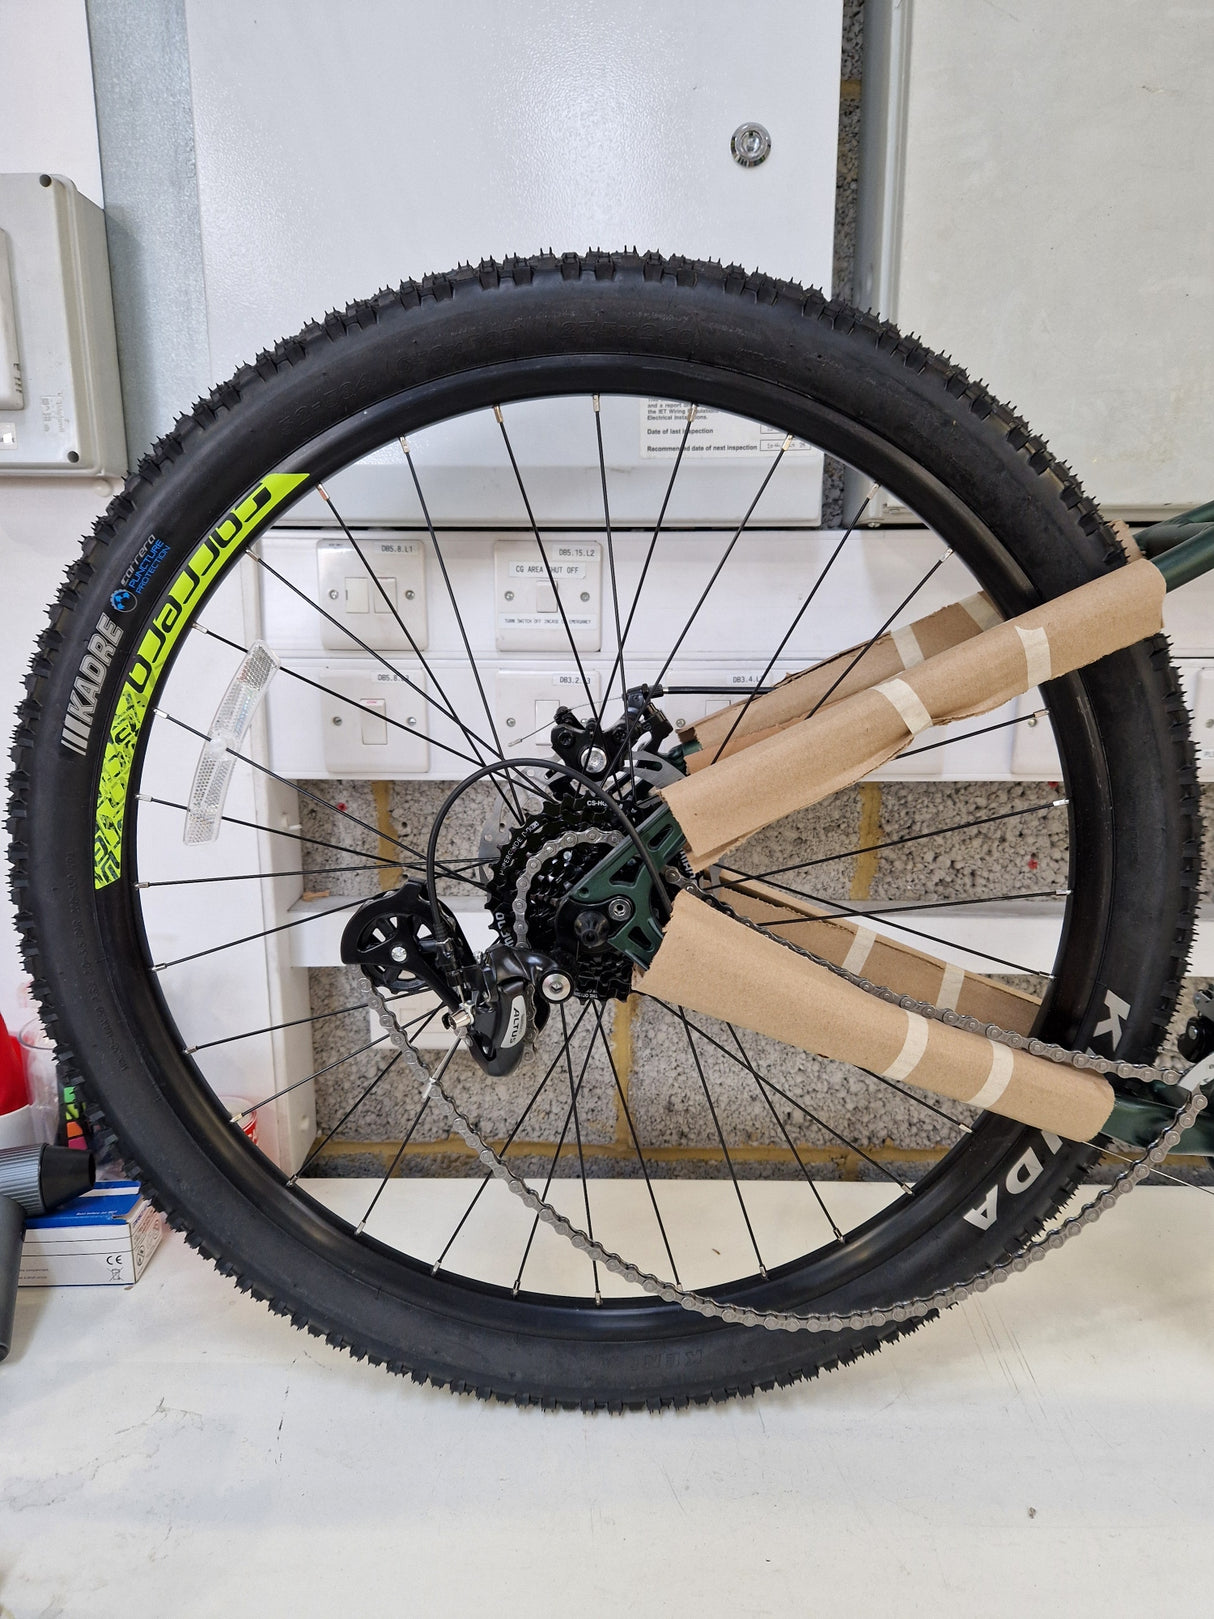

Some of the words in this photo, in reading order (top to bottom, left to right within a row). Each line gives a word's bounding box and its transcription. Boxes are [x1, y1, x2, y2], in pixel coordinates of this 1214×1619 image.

[683, 427, 714, 437] ispection
[121, 534, 156, 587] carrera
[128, 539, 165, 588] PUNCTURE
[381, 545, 413, 553] DB5.8.L1
[558, 548, 595, 557] DB5.15.L2
[135, 545, 171, 595] PROTECTION
[515, 565, 525, 573] CG
[527, 565, 544, 573] AREA
[548, 566, 563, 574] HUT
[566, 566, 579, 574] OFF
[126, 483, 272, 694] carrera
[66, 611, 124, 726] KADRE
[559, 676, 591, 684] DB3.2.3
[509, 1007, 521, 1044] ALTUS
